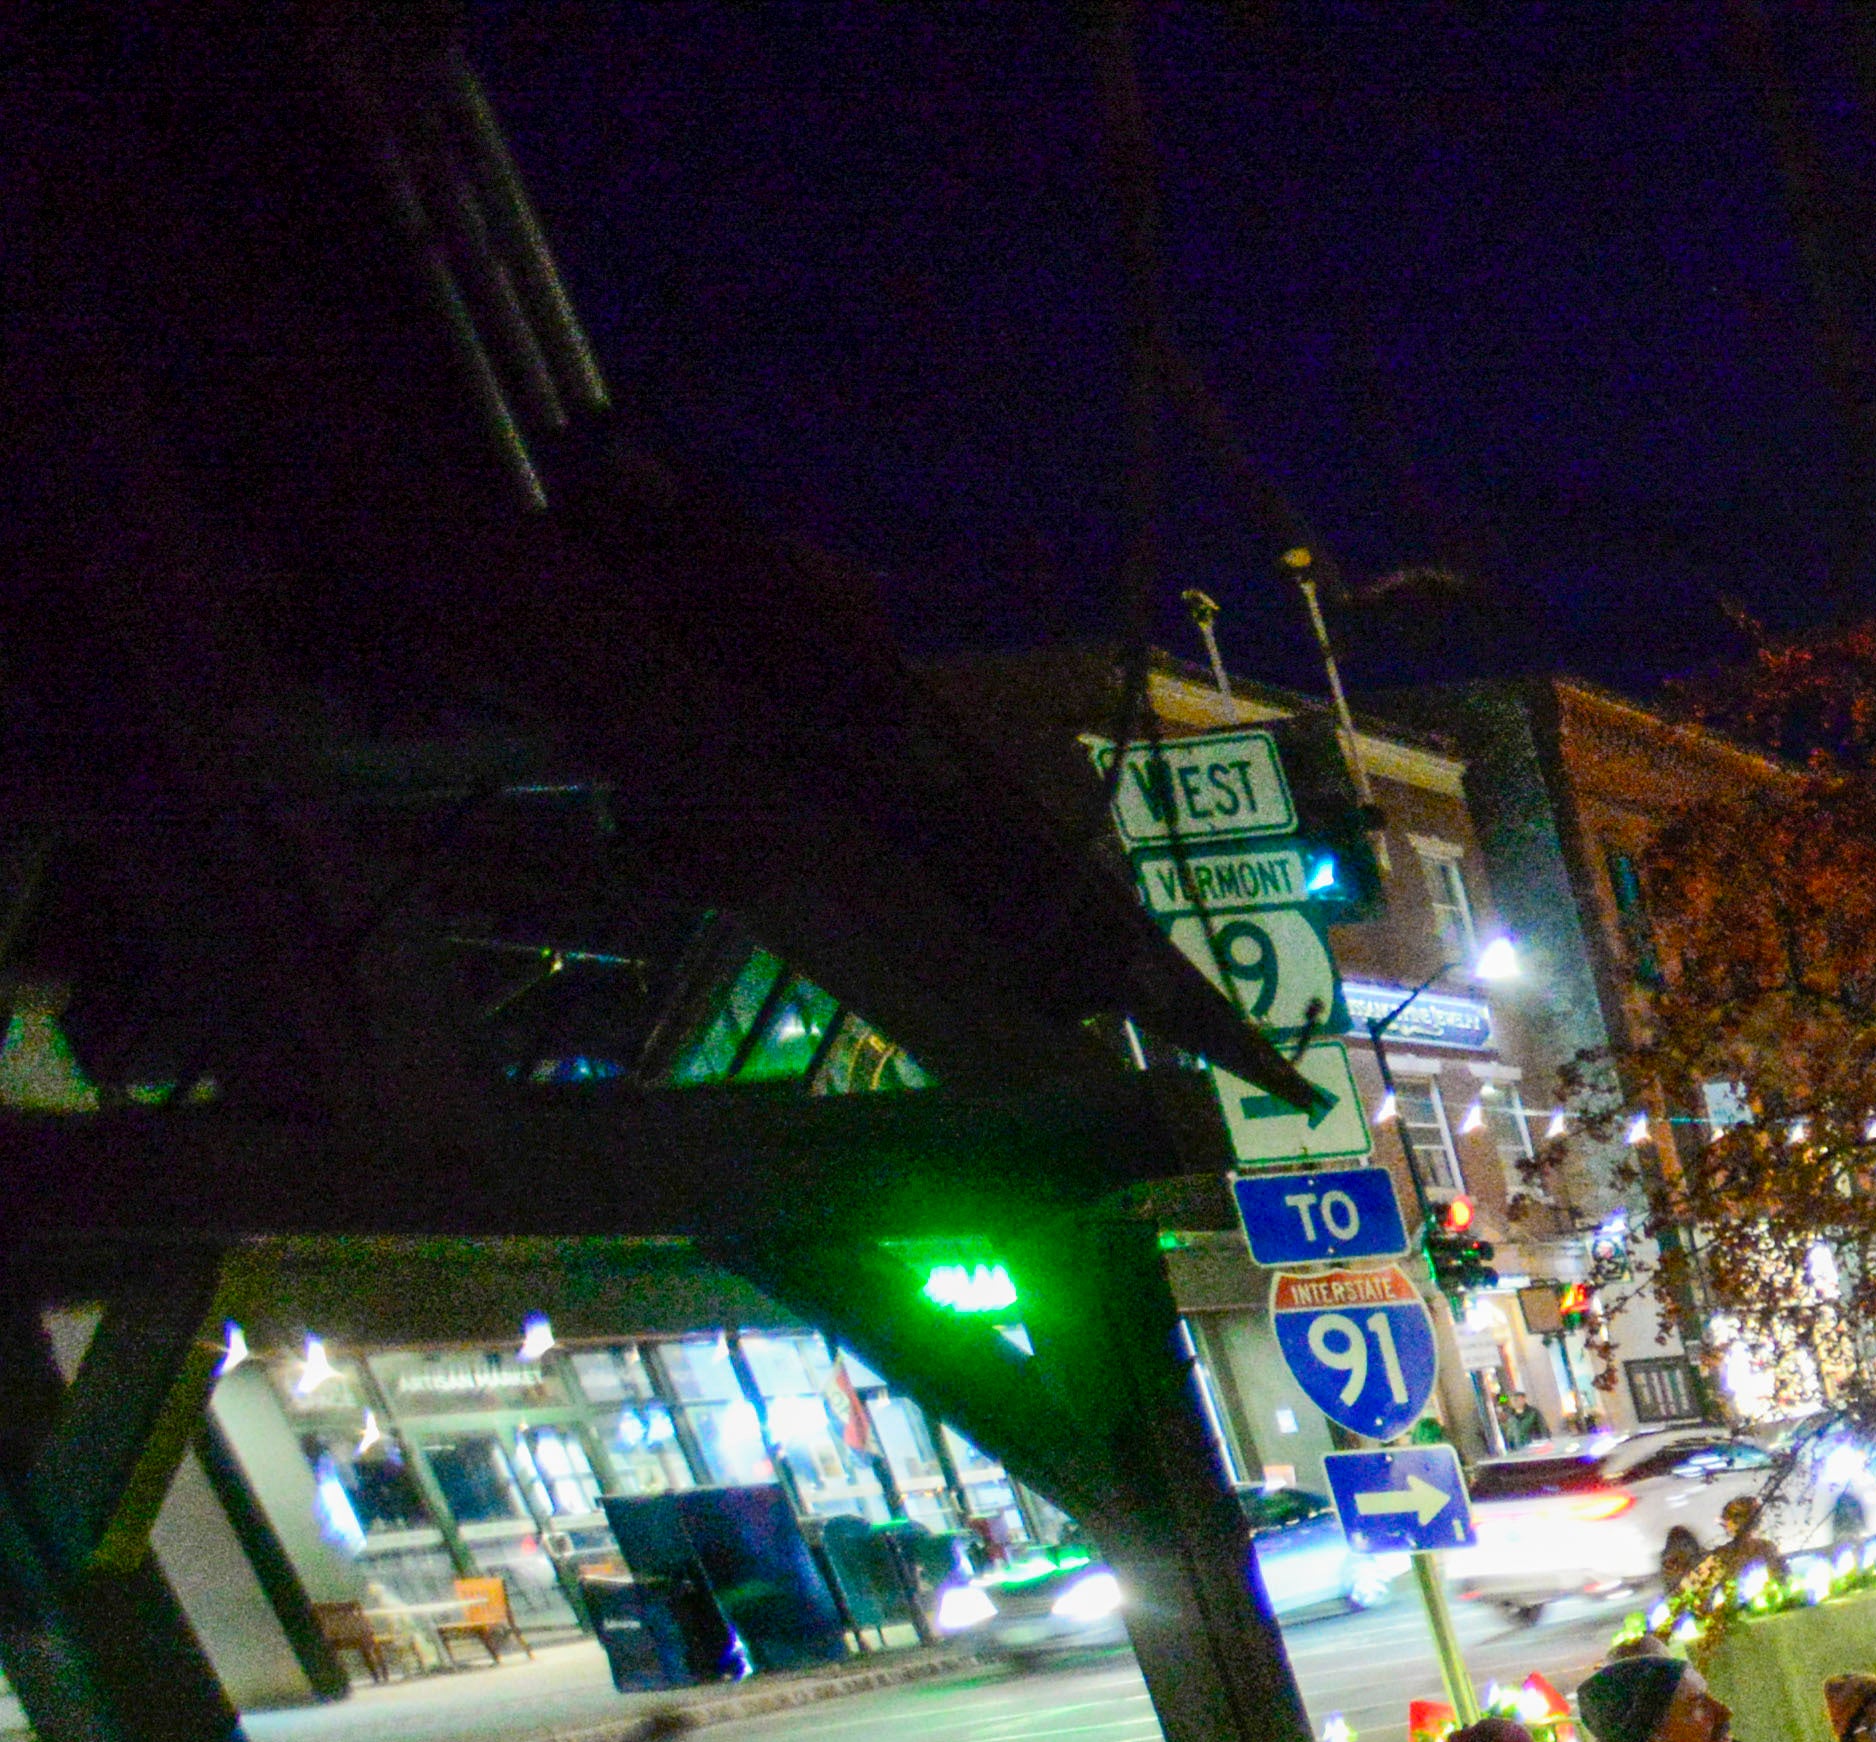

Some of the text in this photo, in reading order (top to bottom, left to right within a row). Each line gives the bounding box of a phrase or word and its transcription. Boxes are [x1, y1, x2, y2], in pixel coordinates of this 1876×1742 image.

[1128, 758, 1257, 823] WEST
[1211, 920, 1279, 1017] 9
[1284, 1190, 1360, 1243] TO
[1291, 1278, 1396, 1306] INTERSTATE
[397, 1367, 544, 1394] ARTISAN MARKET
[1307, 1312, 1409, 1407] 91
